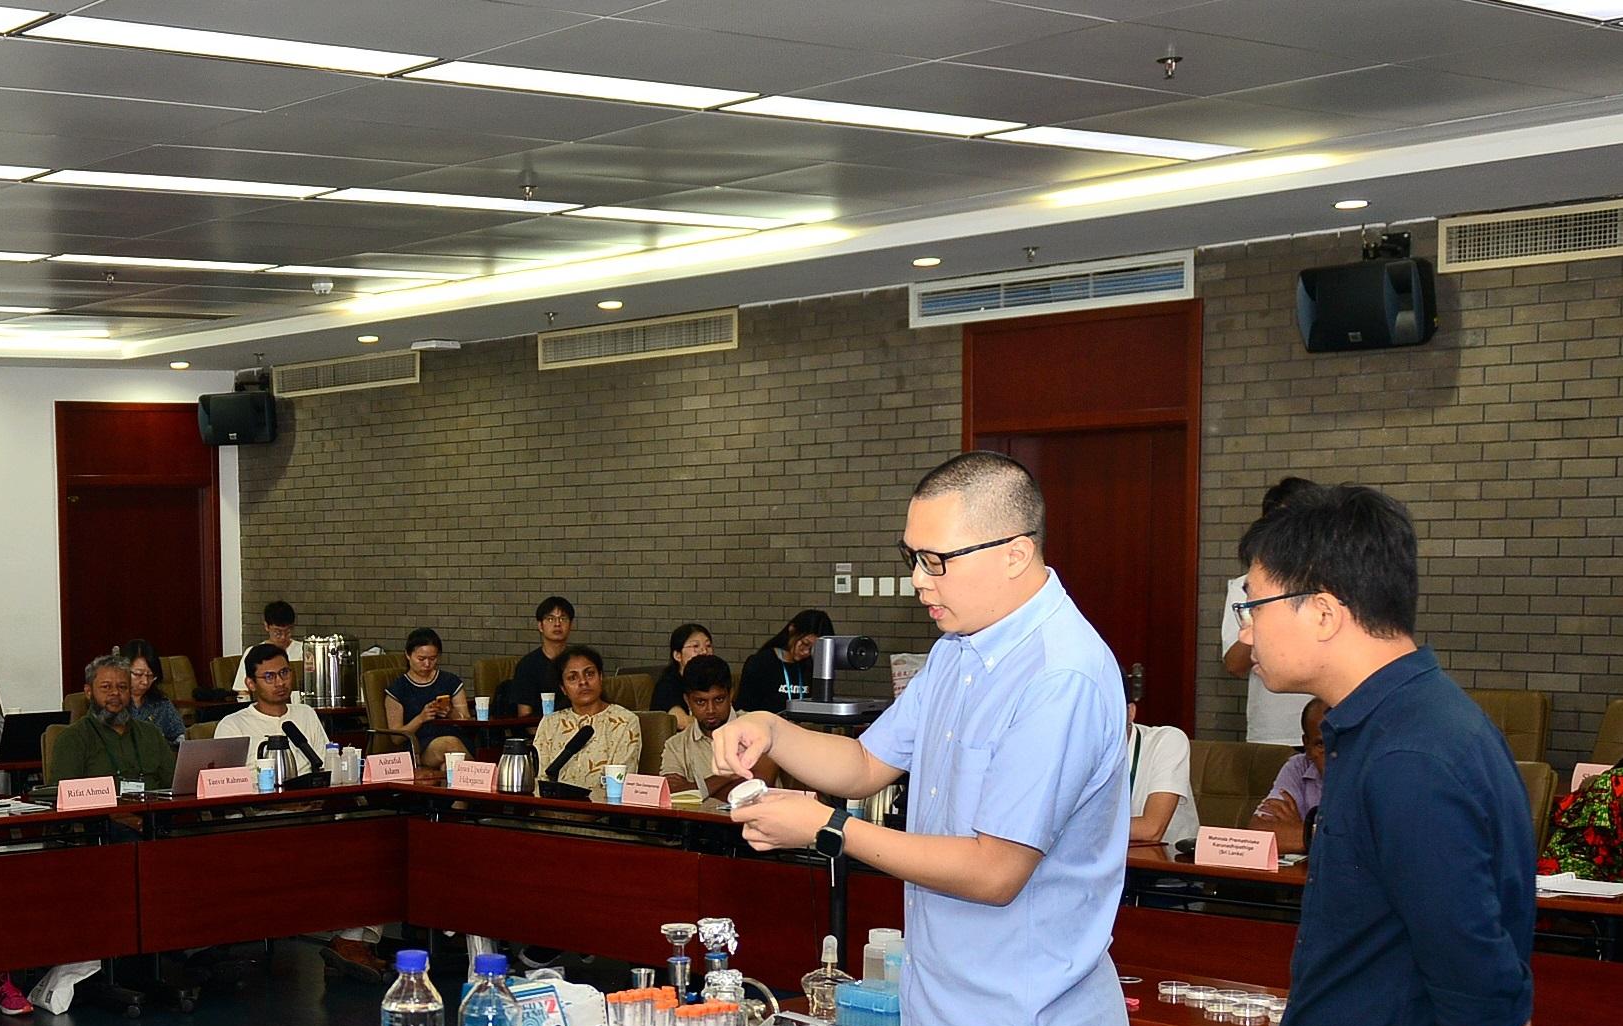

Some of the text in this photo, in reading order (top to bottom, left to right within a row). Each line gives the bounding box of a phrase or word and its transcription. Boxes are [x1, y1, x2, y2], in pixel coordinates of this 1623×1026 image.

[226, 776, 249, 784] Rahman
[68, 790, 84, 798] Rifat
[86, 787, 110, 796] Ahmed
